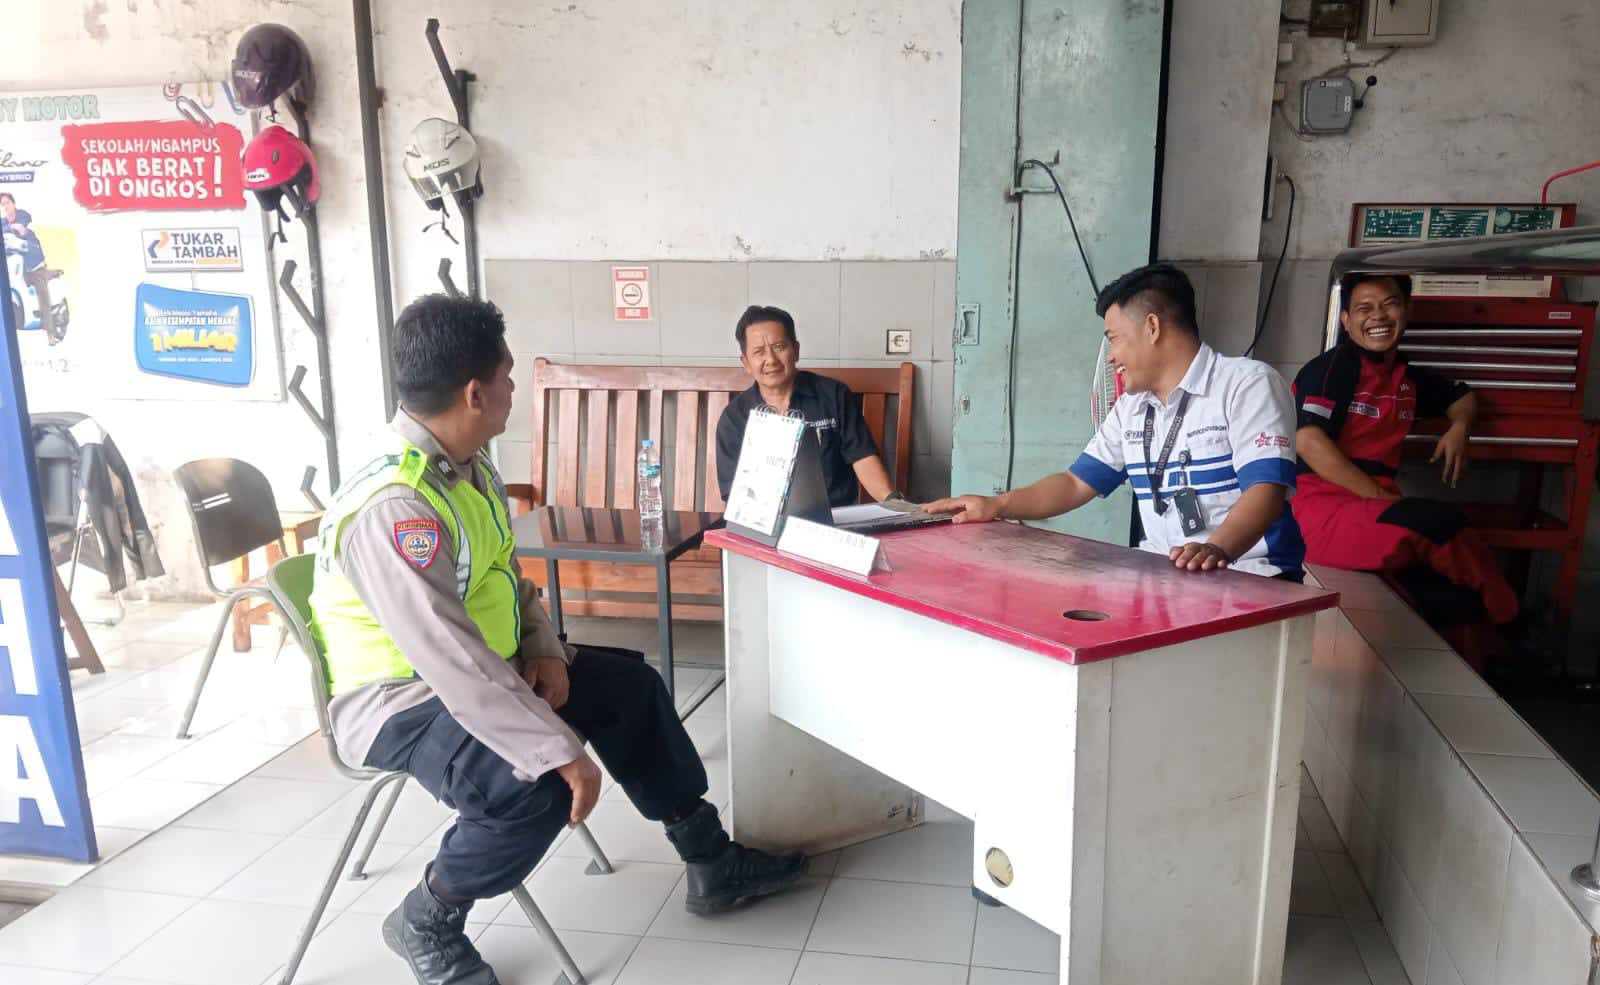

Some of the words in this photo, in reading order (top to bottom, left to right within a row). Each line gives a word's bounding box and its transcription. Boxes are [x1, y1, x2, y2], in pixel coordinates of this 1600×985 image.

[22, 95, 100, 121] MOTOR
[81, 137, 221, 154] SEKOLAH/NGAMPUS
[87, 157, 128, 177] GAK
[137, 157, 205, 179] BERAT
[89, 177, 111, 197] DI
[119, 178, 208, 199] ONGKOS
[171, 232, 224, 245] TUKAR
[172, 246, 238, 258] TAMBAH
